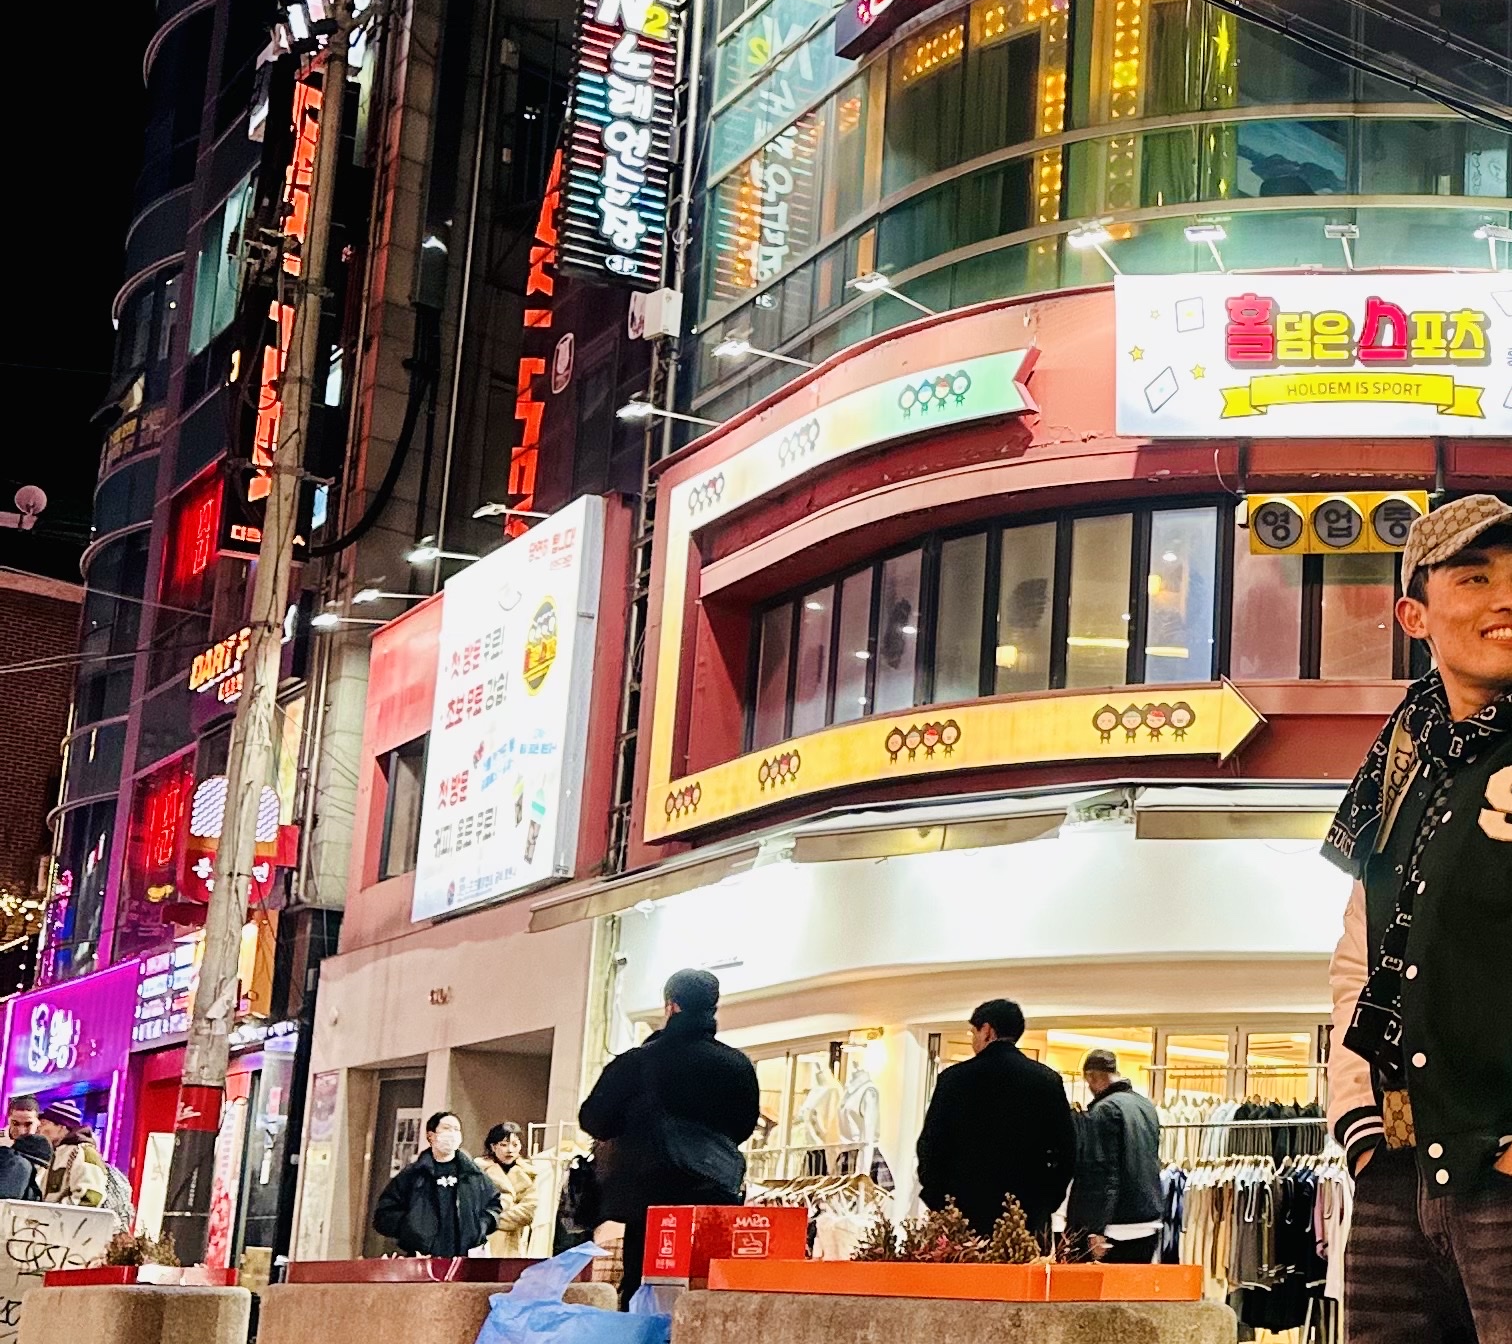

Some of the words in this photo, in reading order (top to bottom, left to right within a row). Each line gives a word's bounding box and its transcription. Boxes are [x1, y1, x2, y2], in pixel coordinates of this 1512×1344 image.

[598, 32, 656, 252] 노래연습장
[1286, 382, 1353, 397] HOLDEM
[1356, 382, 1370, 396] IS
[1372, 381, 1423, 397] SPORT
[1261, 504, 1411, 544] 영업중
